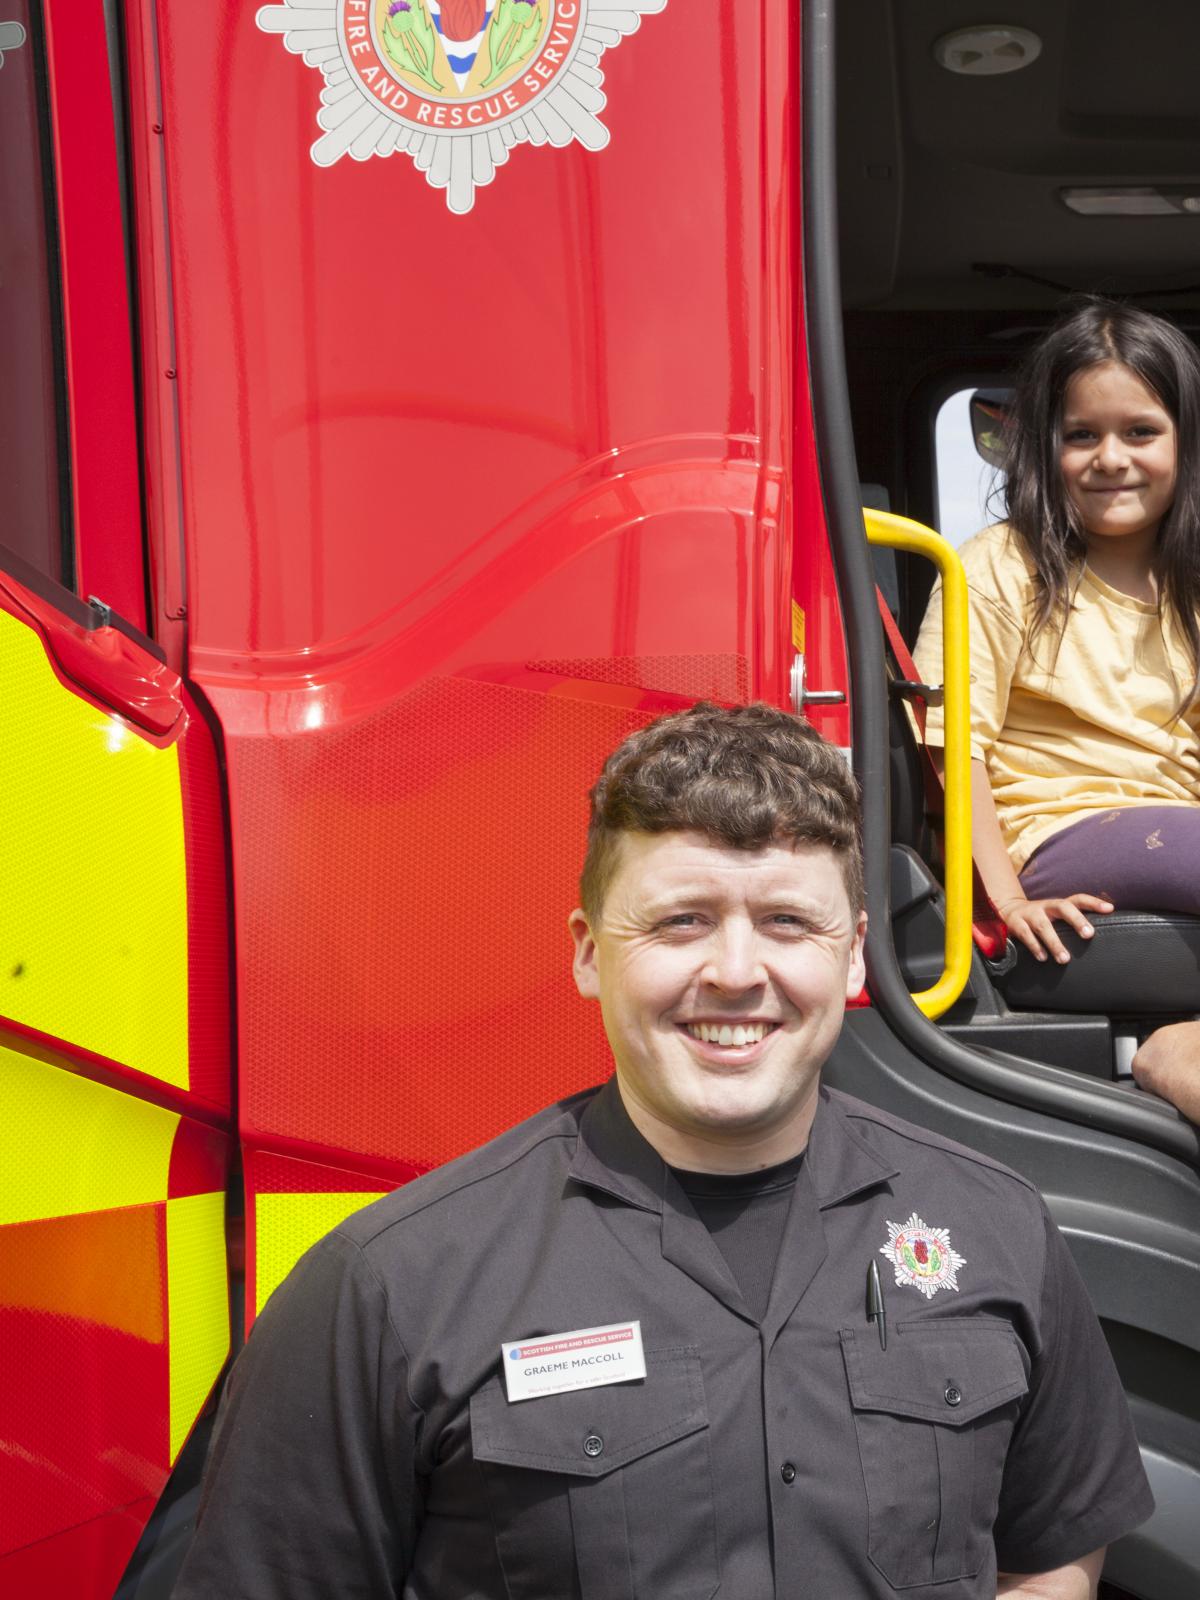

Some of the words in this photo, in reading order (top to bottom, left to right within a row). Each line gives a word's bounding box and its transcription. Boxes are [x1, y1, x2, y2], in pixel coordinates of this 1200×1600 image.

[347, 0, 370, 57] FIRE
[361, 65, 408, 110] AND
[416, 90, 520, 126] RESCUE
[523, 1345, 554, 1356] SCOTTISH
[555, 1342, 568, 1351] FIRE
[569, 1340, 583, 1348] AND
[583, 1336, 606, 1345] RESCUE
[607, 1331, 632, 1341] SERVICE
[523, 1361, 569, 1377] GRAEME
[571, 1352, 624, 1369] MACCOLL
